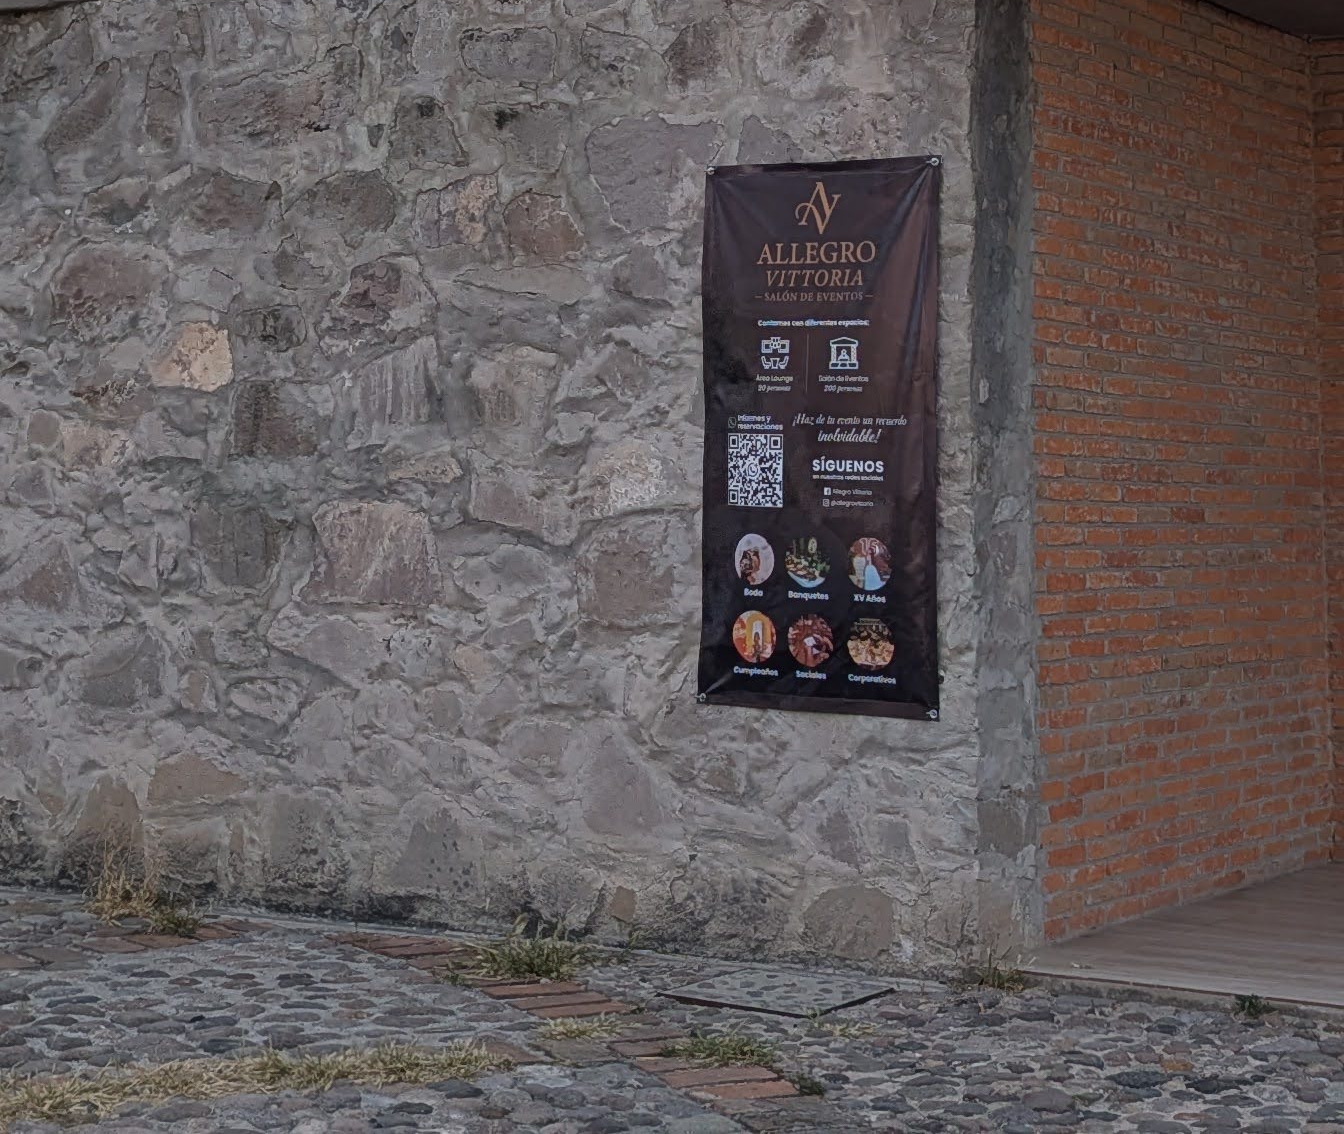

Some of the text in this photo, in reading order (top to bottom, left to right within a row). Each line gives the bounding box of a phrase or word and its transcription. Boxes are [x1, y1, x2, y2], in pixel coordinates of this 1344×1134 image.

[756, 240, 876, 265] ALLEGRO
[766, 268, 864, 287] VITTORIA
[764, 290, 864, 302] SALÓN DE EVENTOS
[770, 374, 794, 384] Lounge
[765, 415, 772, 424] y
[815, 413, 826, 425] de
[826, 415, 835, 425] tu
[836, 415, 861, 425] evento
[875, 414, 907, 426] recuerdo
[817, 427, 882, 444] inolvidable!
[812, 456, 884, 473] SÍGUENOS
[787, 590, 829, 601] Banquetes
[733, 666, 779, 677] Cumpleaños
[847, 673, 897, 686] Corporativos
